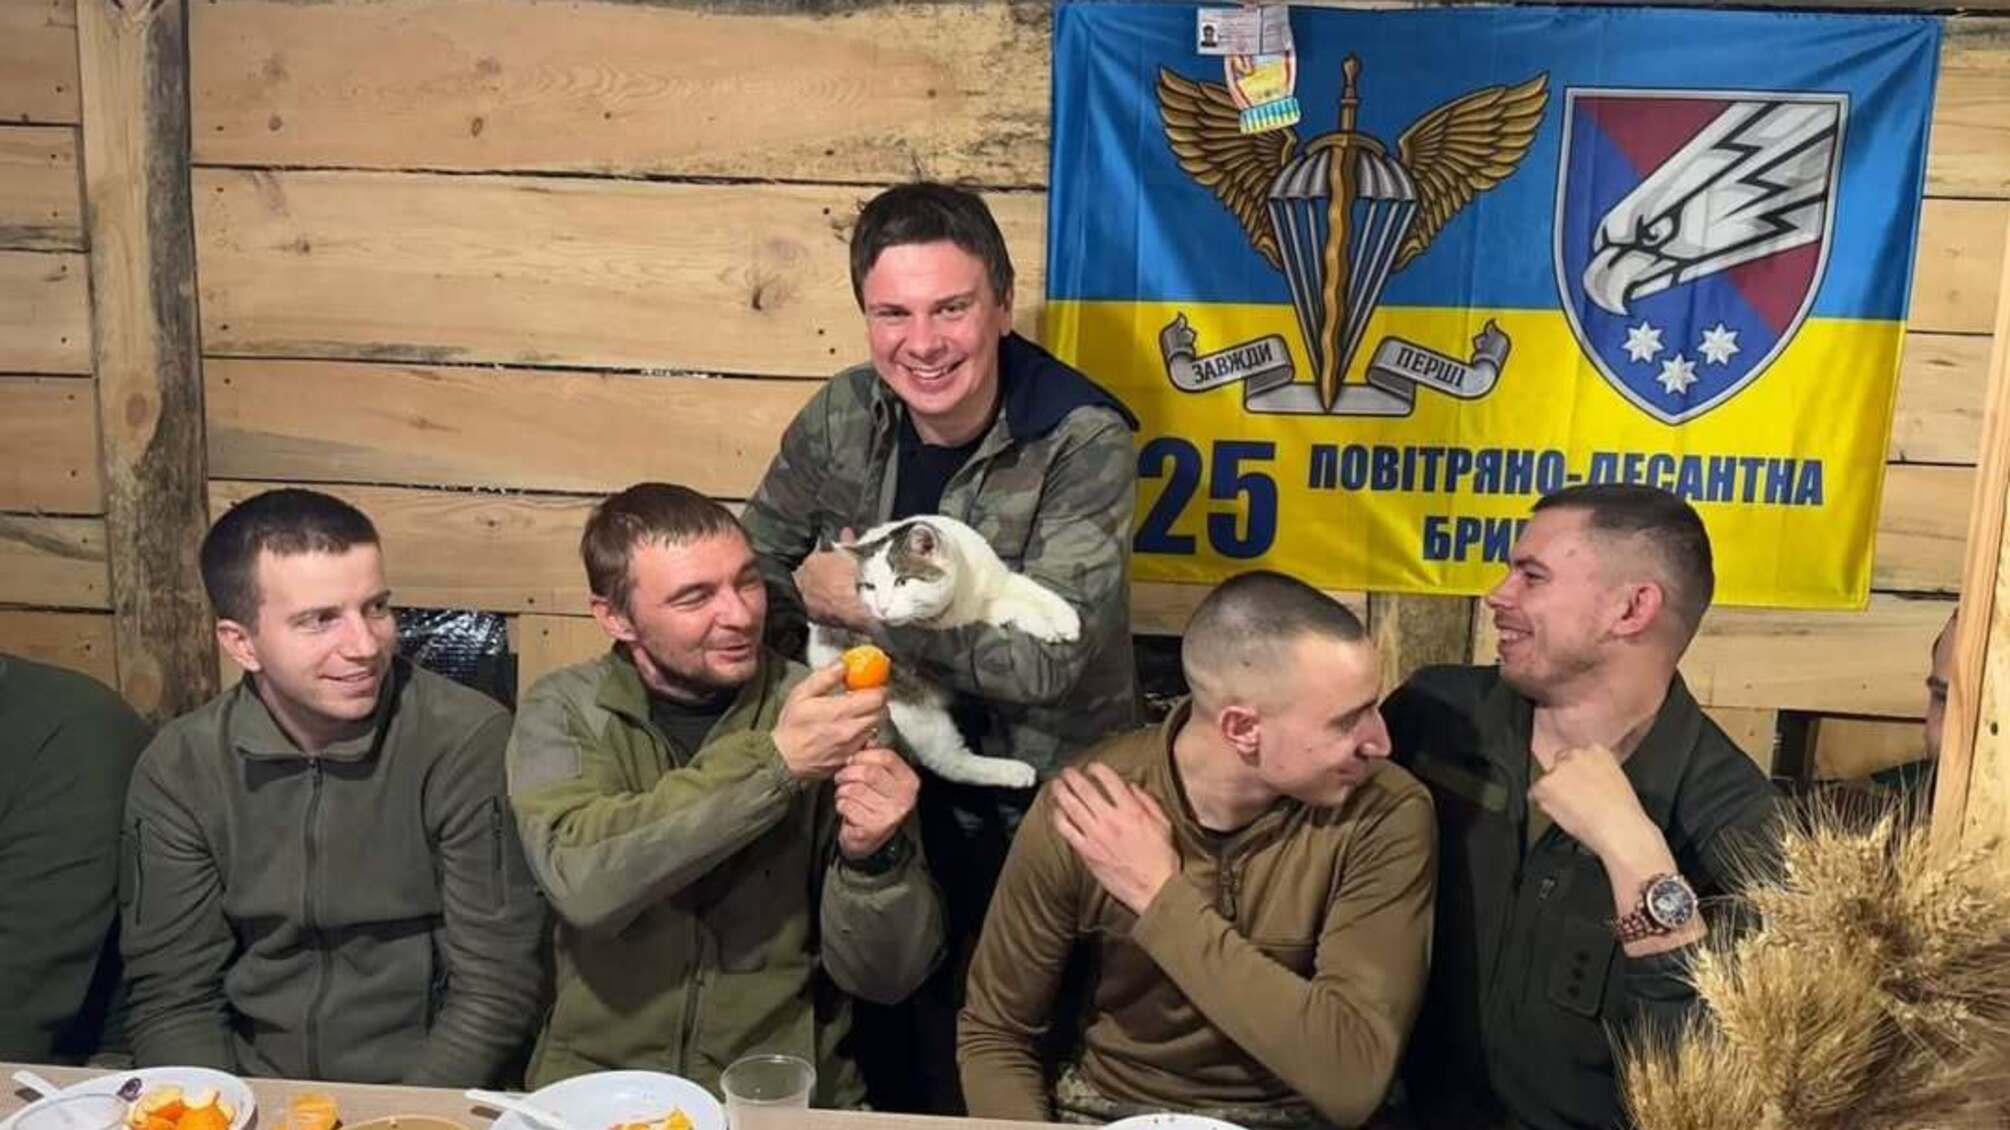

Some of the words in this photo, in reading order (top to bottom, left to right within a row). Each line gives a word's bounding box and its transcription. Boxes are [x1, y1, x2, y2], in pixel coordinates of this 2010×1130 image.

[1191, 343, 1274, 386] ЗАВЖДИ
[1396, 346, 1466, 388] ПЕРШІ
[1133, 436, 1279, 560] 25
[1422, 515, 1529, 563] БРИ
